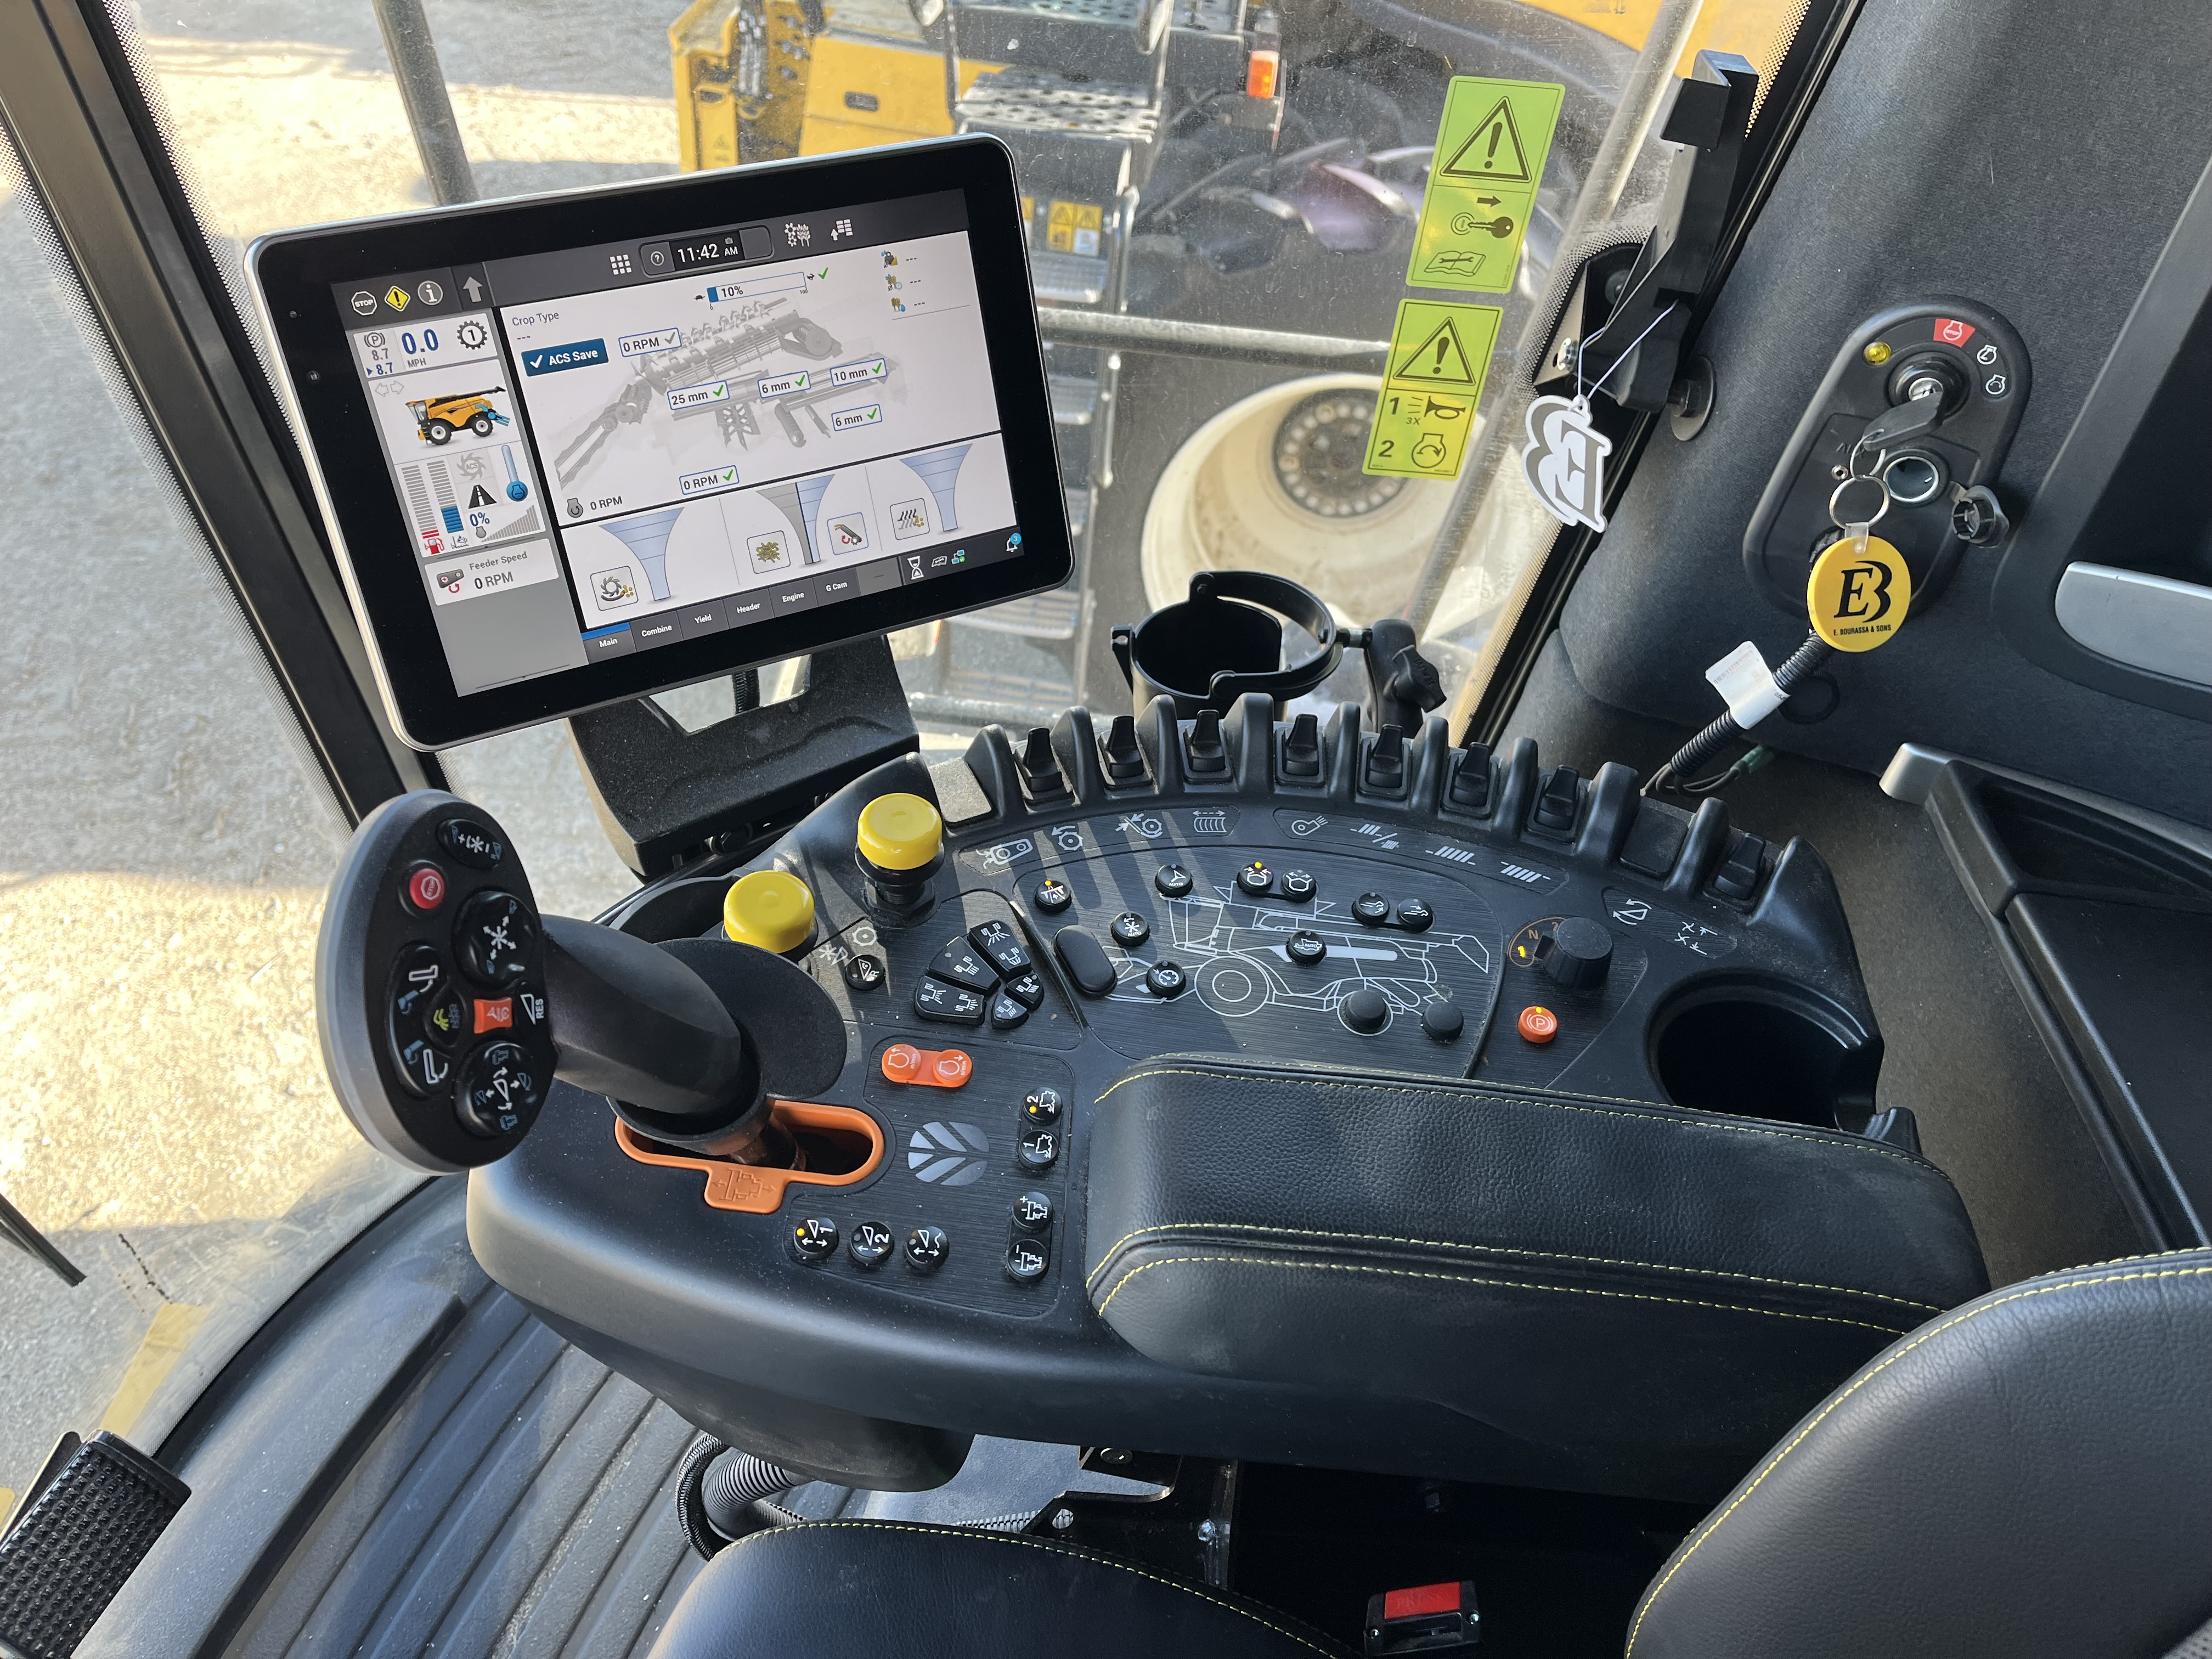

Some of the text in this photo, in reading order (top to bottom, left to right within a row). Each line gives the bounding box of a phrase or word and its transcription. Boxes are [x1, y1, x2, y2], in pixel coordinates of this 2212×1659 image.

[678, 243, 738, 263] 11:42 AM
[721, 285, 744, 297] 10%
[354, 299, 374, 308] STOP
[512, 311, 560, 328] Crop Type
[401, 329, 439, 354] 0.0
[467, 329, 476, 341] 1
[623, 336, 659, 352] 0 RPM
[371, 348, 389, 361] 8.7
[549, 349, 599, 366] ACS Save
[376, 362, 393, 375] 8.7
[407, 357, 427, 368] MPH
[833, 368, 868, 382] 10 mm
[761, 380, 791, 394] 6 mm
[671, 390, 709, 406] 25 mm
[1389, 397, 1421, 425] 1 3X
[835, 413, 863, 427] 6 mm
[1378, 439, 1395, 458] 2
[466, 461, 478, 471] ACS
[683, 474, 719, 490] 0 RPM
[590, 495, 623, 510] 0 RPM
[469, 512, 490, 527] 0%
[469, 551, 528, 571] Feeder Speed
[474, 571, 514, 590] 0 RPM
[832, 581, 848, 590] Cam
[782, 591, 805, 603] Engine
[736, 602, 761, 614] Header
[694, 613, 712, 624] Yield
[641, 624, 673, 637] Combine
[1840, 626, 1870, 635] BOURASSA
[599, 637, 618, 648] Main
[1528, 929, 1539, 940] N
[1517, 945, 1526, 958] 1
[535, 998, 544, 1019] RES
[1536, 1018, 1546, 1028] P
[874, 1233, 889, 1244] 2
